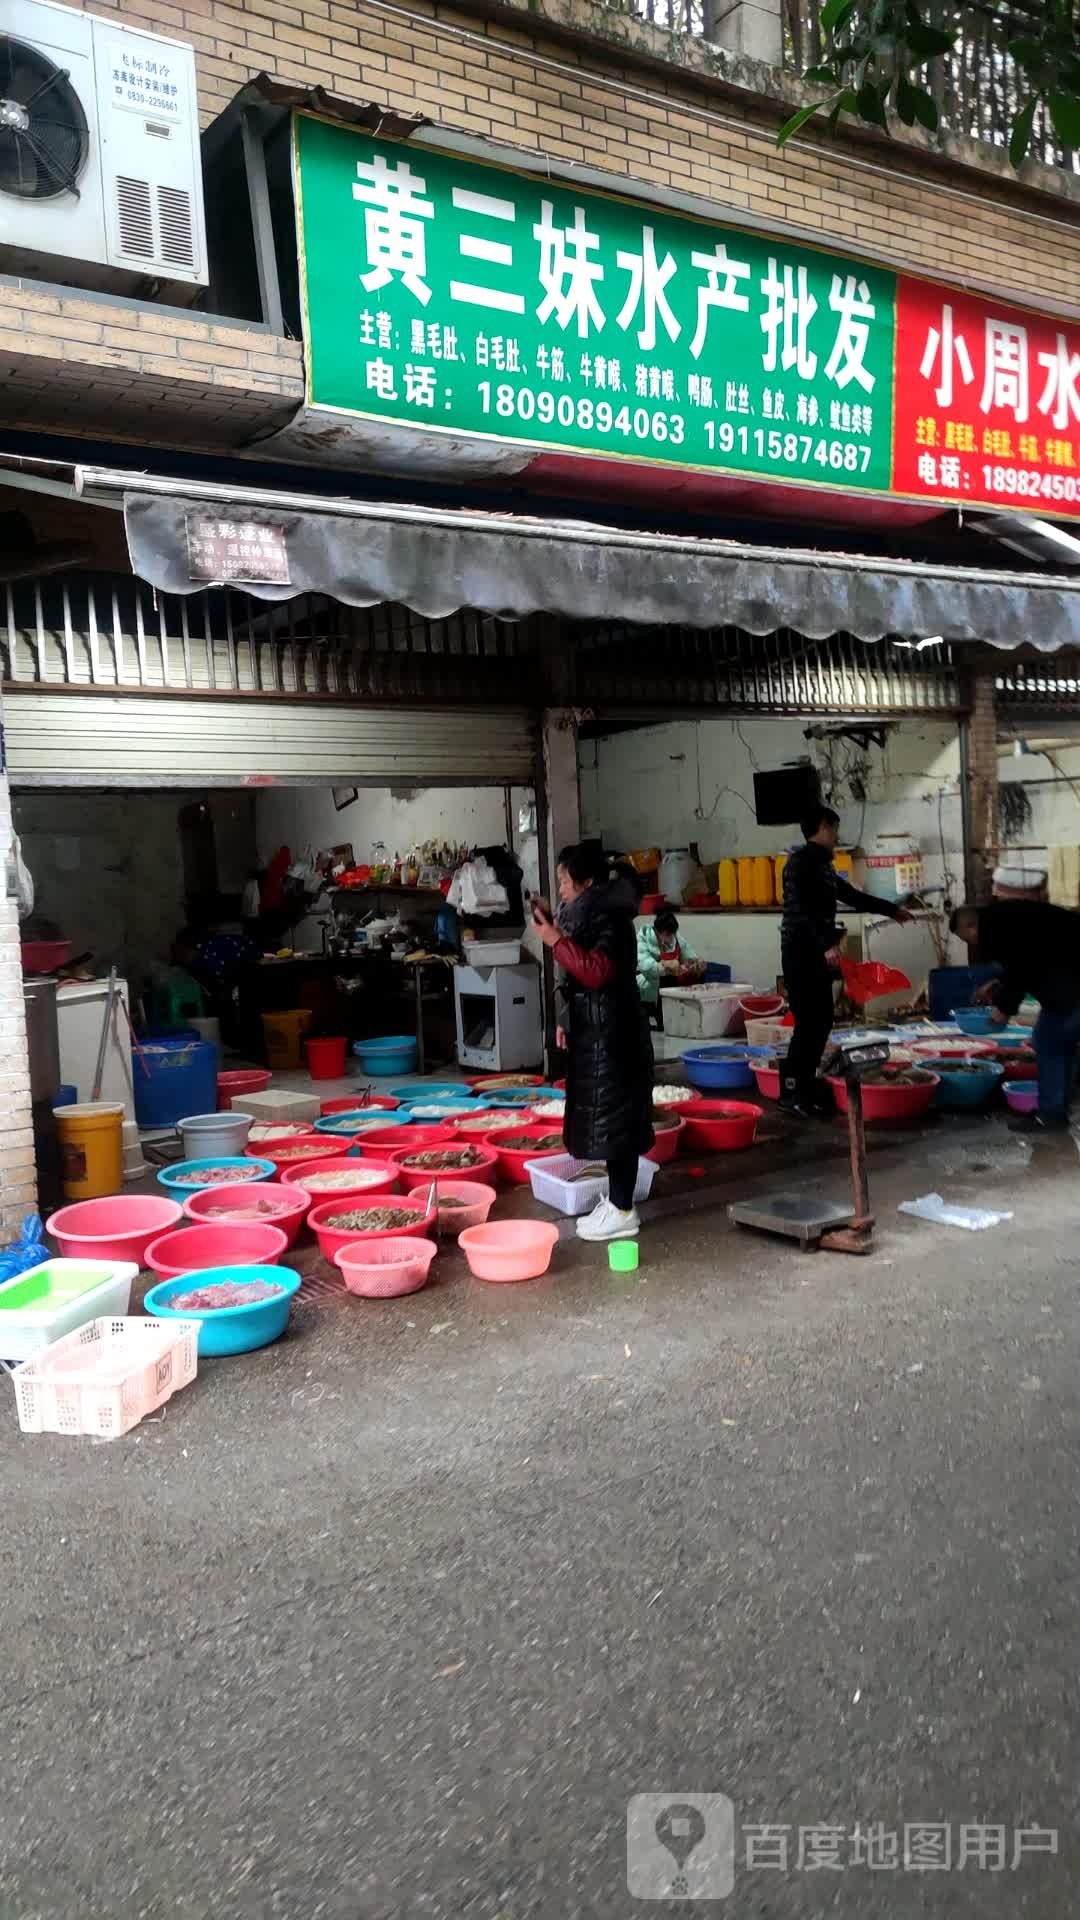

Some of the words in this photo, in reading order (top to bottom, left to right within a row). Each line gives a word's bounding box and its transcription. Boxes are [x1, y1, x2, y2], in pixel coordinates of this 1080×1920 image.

[351, 154, 876, 394] 黄三妹水产批发
[365, 356, 452, 410] 电话：
[477, 381, 685, 444] 18090894063
[703, 420, 872, 473] 19115874687
[917, 451, 971, 490] 电话：
